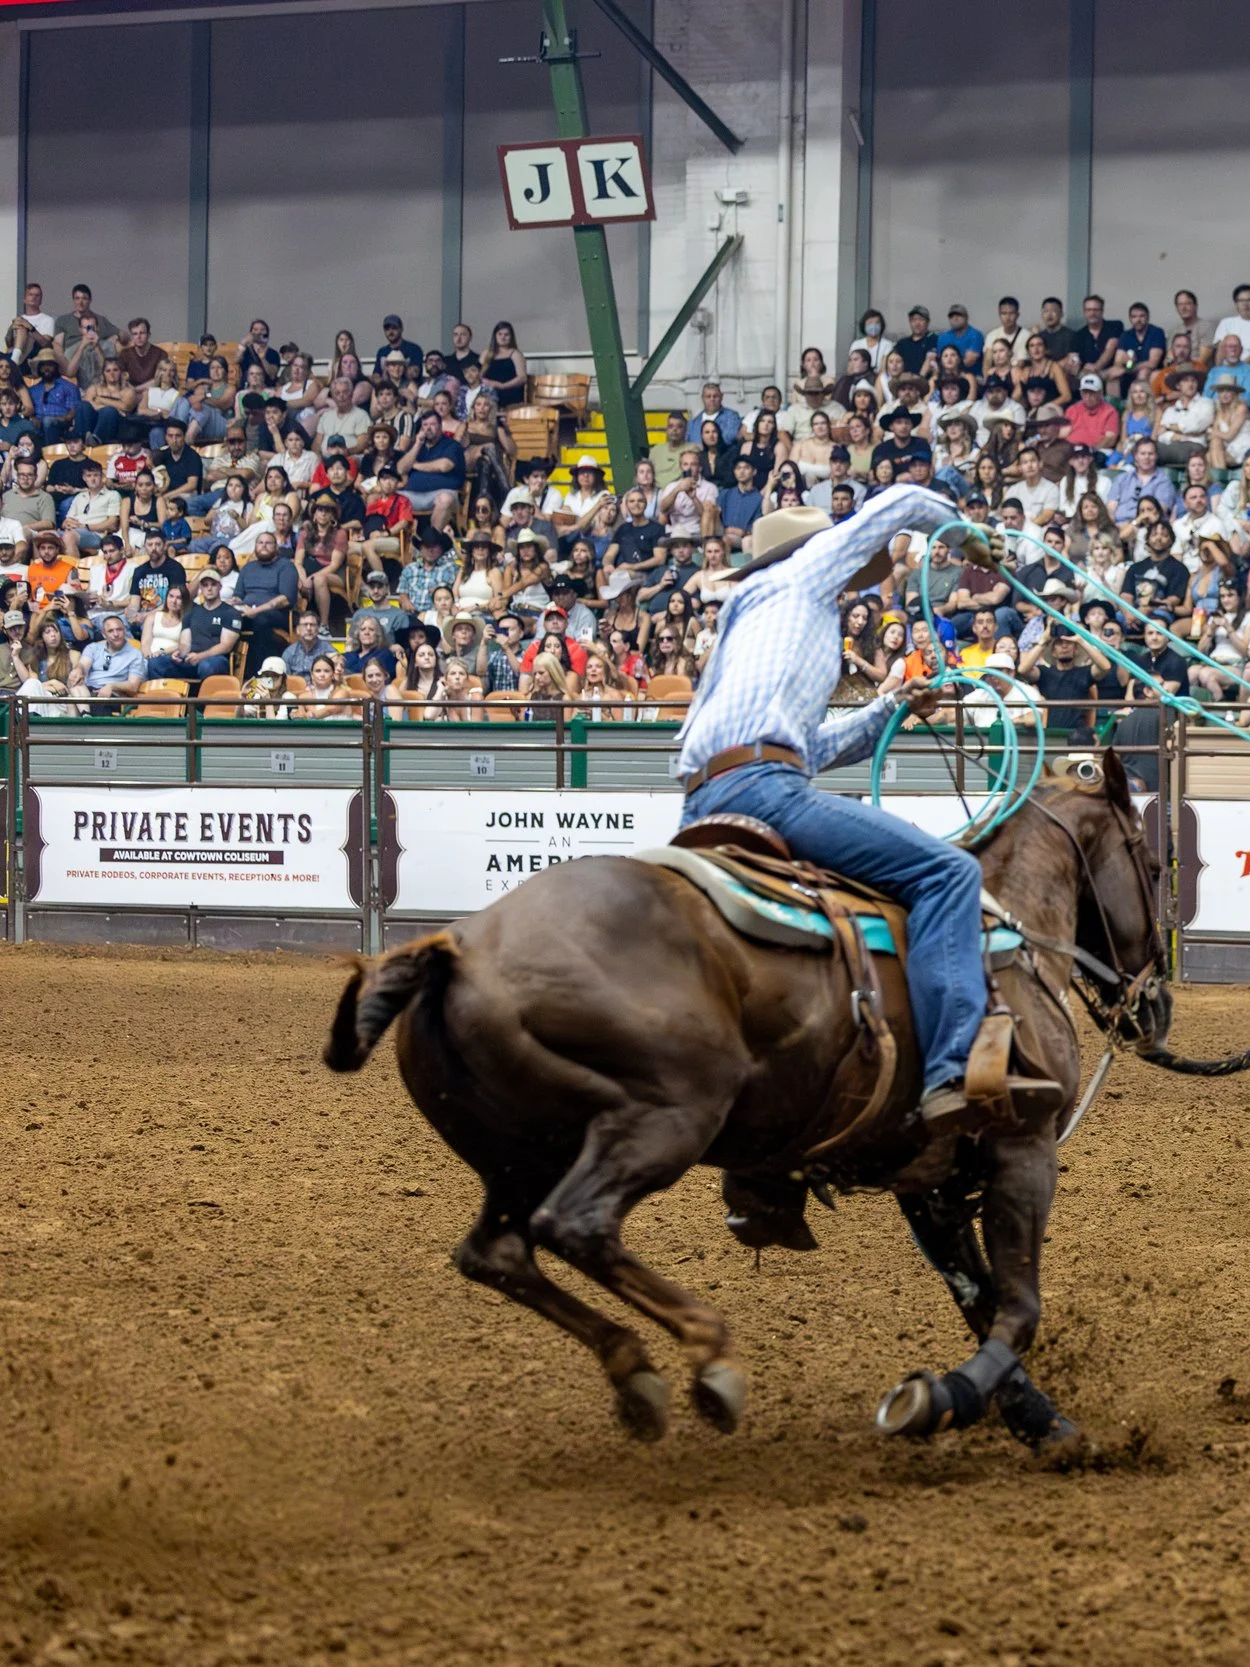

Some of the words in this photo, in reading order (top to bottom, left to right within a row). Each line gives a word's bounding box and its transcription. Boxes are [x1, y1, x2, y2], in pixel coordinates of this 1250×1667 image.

[523, 162, 554, 205] J
[585, 155, 641, 201] K
[477, 766, 488, 775] 10
[485, 812, 544, 828] JOHN
[556, 812, 635, 829] WAYNE
[73, 811, 188, 843] PRIVATE
[200, 812, 313, 844] EVENTS
[548, 836, 571, 848] AN
[113, 850, 160, 861] AVAILABLE
[161, 851, 173, 861] AT
[174, 851, 223, 862] COWTOWN
[224, 852, 270, 863] COLISEUM
[66, 870, 99, 879] PRIVATE
[101, 871, 137, 880] RODEOS,
[139, 871, 189, 880] CORPORATE
[191, 872, 227, 882] EVENTS,
[228, 873, 282, 882] RECEPTIONS
[284, 874, 290, 882] &
[292, 874, 319, 883] MORE!
